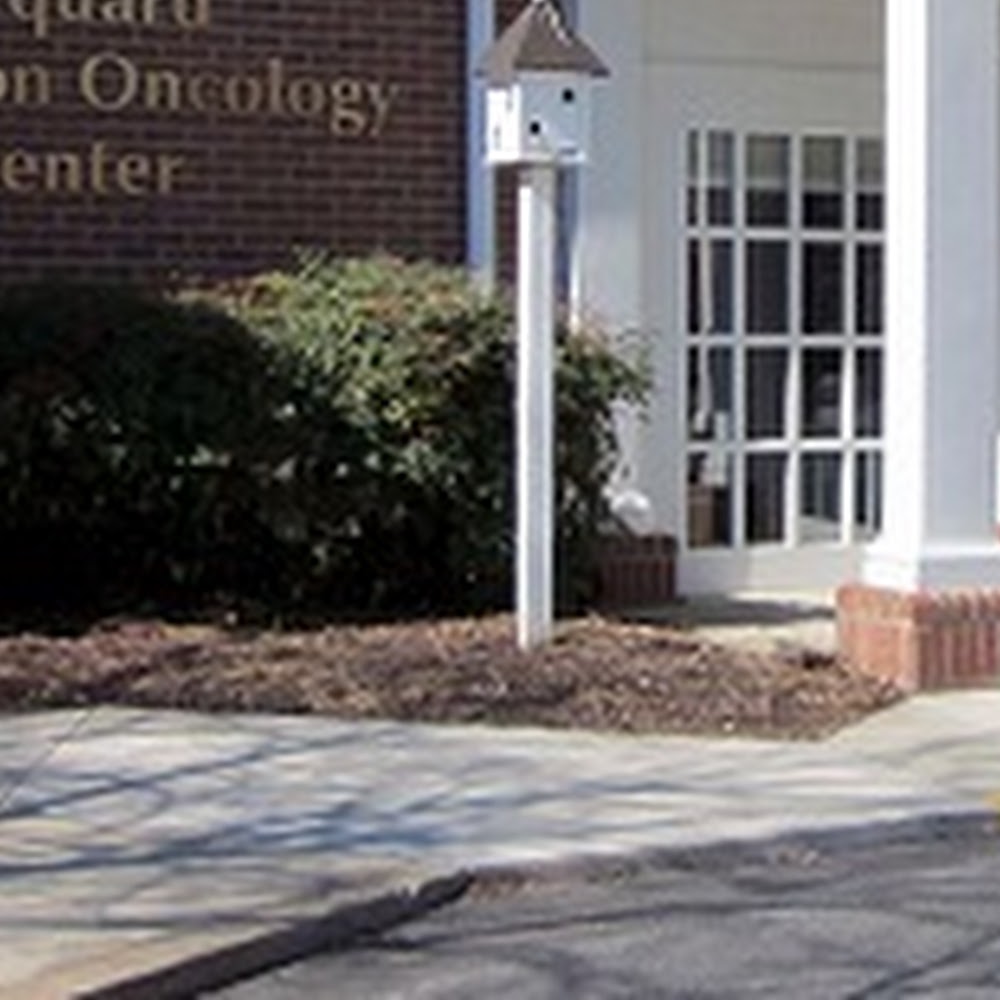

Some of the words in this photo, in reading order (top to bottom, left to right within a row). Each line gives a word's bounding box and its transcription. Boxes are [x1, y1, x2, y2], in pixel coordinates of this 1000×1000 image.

[0, 61, 51, 105] n
[79, 51, 398, 137] Oncology
[1, 140, 185, 195] enter
